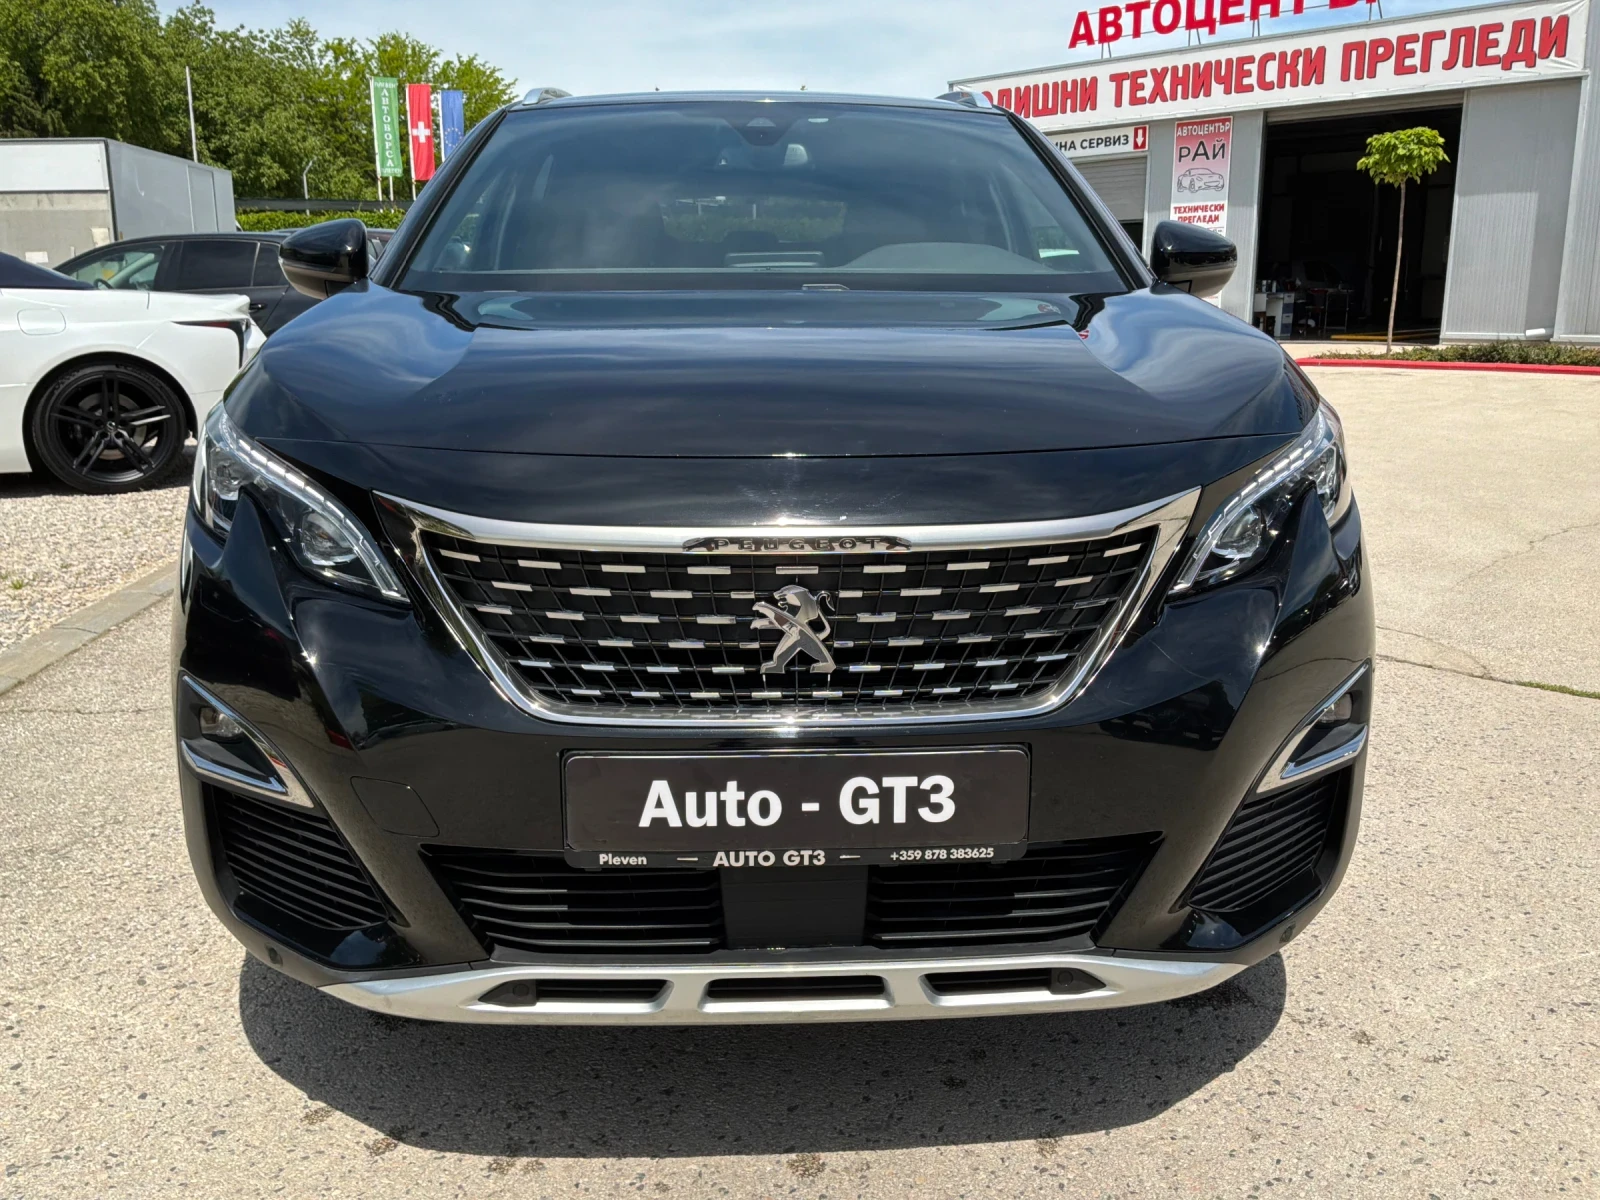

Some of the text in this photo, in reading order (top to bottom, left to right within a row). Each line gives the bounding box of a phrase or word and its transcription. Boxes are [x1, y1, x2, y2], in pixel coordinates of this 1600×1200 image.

[1109, 45, 1327, 107] ТЕХНИЧЕСКИ
[1340, 14, 1570, 82] ПРЕГЛЕДИ
[1080, 134, 1129, 150] СЕРВИЗ
[1178, 138, 1226, 163] РАЙ
[1173, 203, 1225, 215] ТЕХНИЧЕСКИ
[1177, 214, 1220, 225] ПРЕГЛЕДИ
[713, 537, 881, 551] PEUGEOT
[638, 780, 783, 828] Auto
[839, 774, 956, 825] GT3
[599, 847, 995, 868] Pleven AUTO GT3 +359 878 383625
